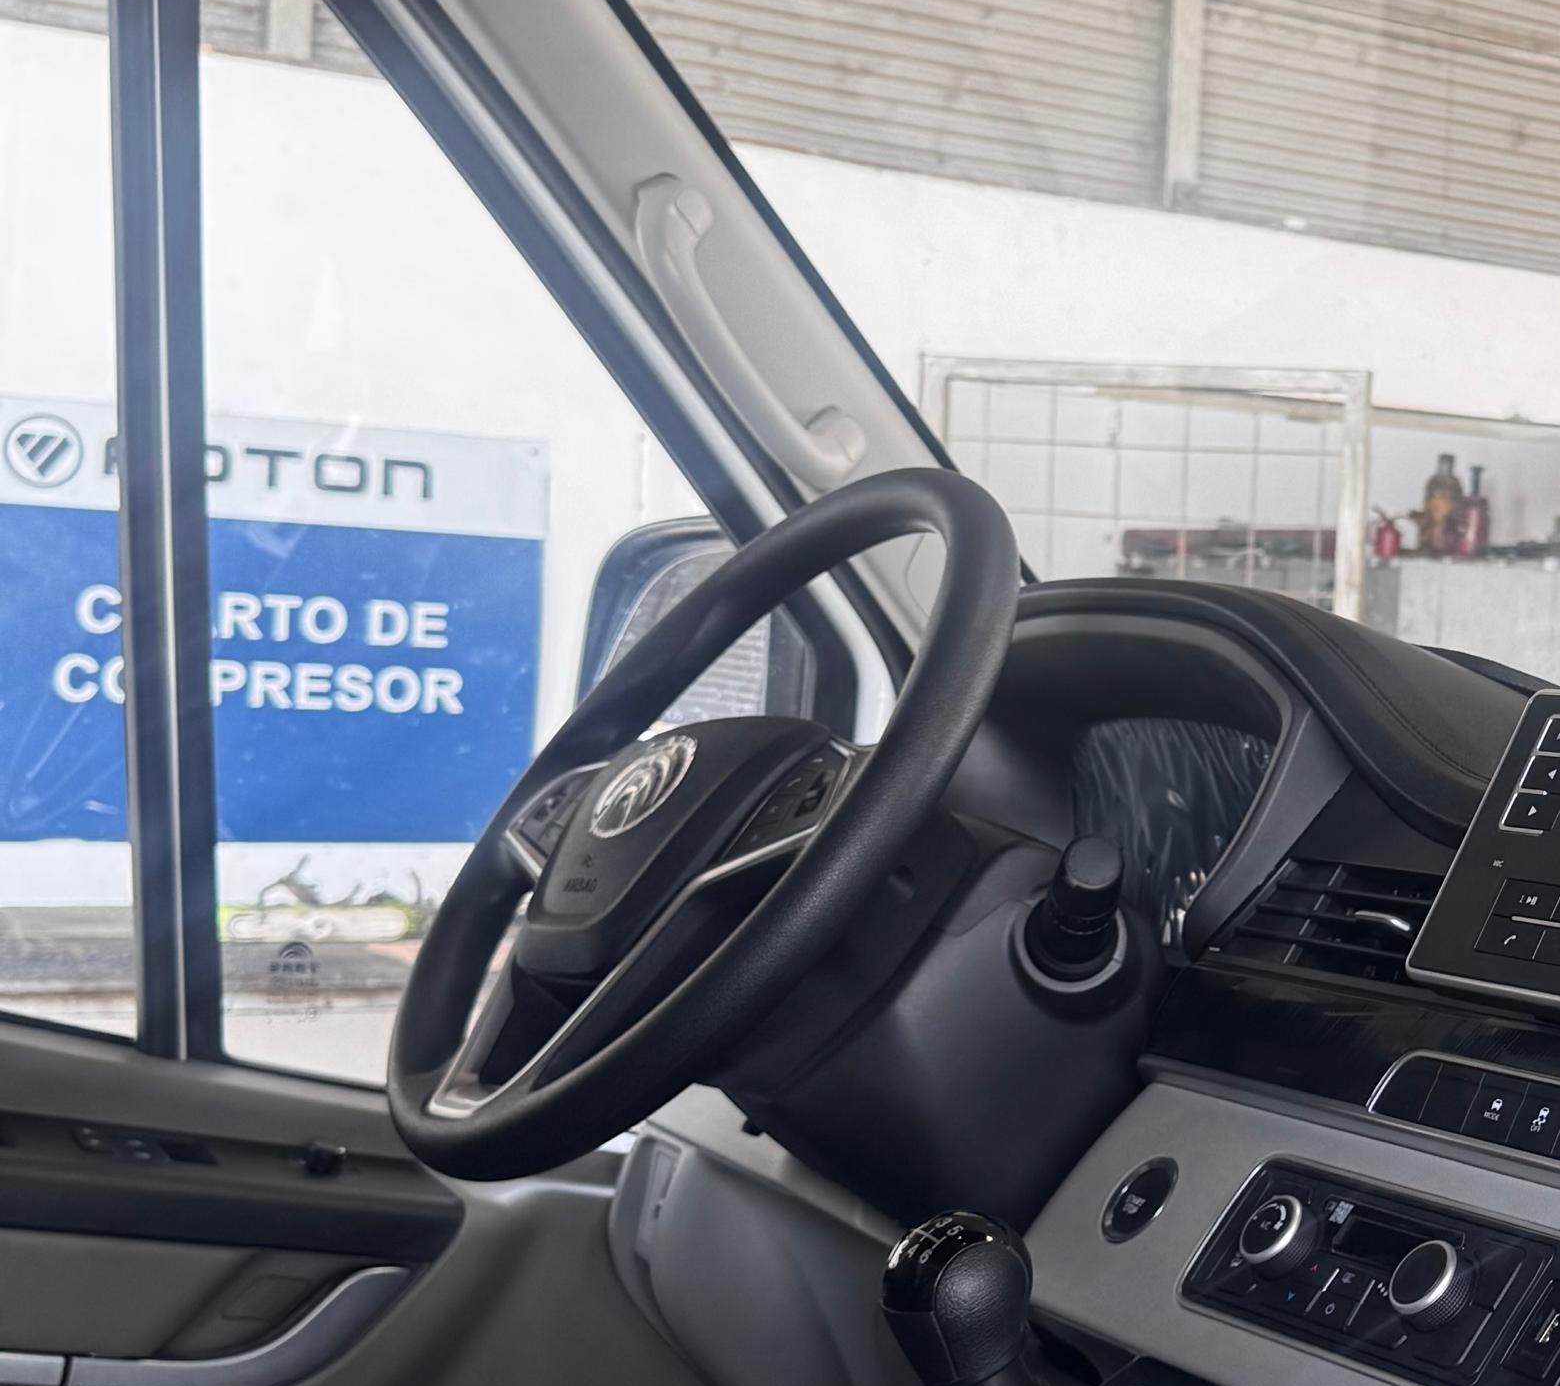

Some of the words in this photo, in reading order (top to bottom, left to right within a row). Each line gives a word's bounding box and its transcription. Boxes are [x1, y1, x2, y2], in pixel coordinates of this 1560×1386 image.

[74, 583, 350, 644] CRTO
[364, 599, 450, 649] DE
[53, 652, 464, 715] CPRESOR
[946, 1224, 965, 1236] 5
[907, 1243, 920, 1259] 4
[919, 1248, 933, 1264] 6
